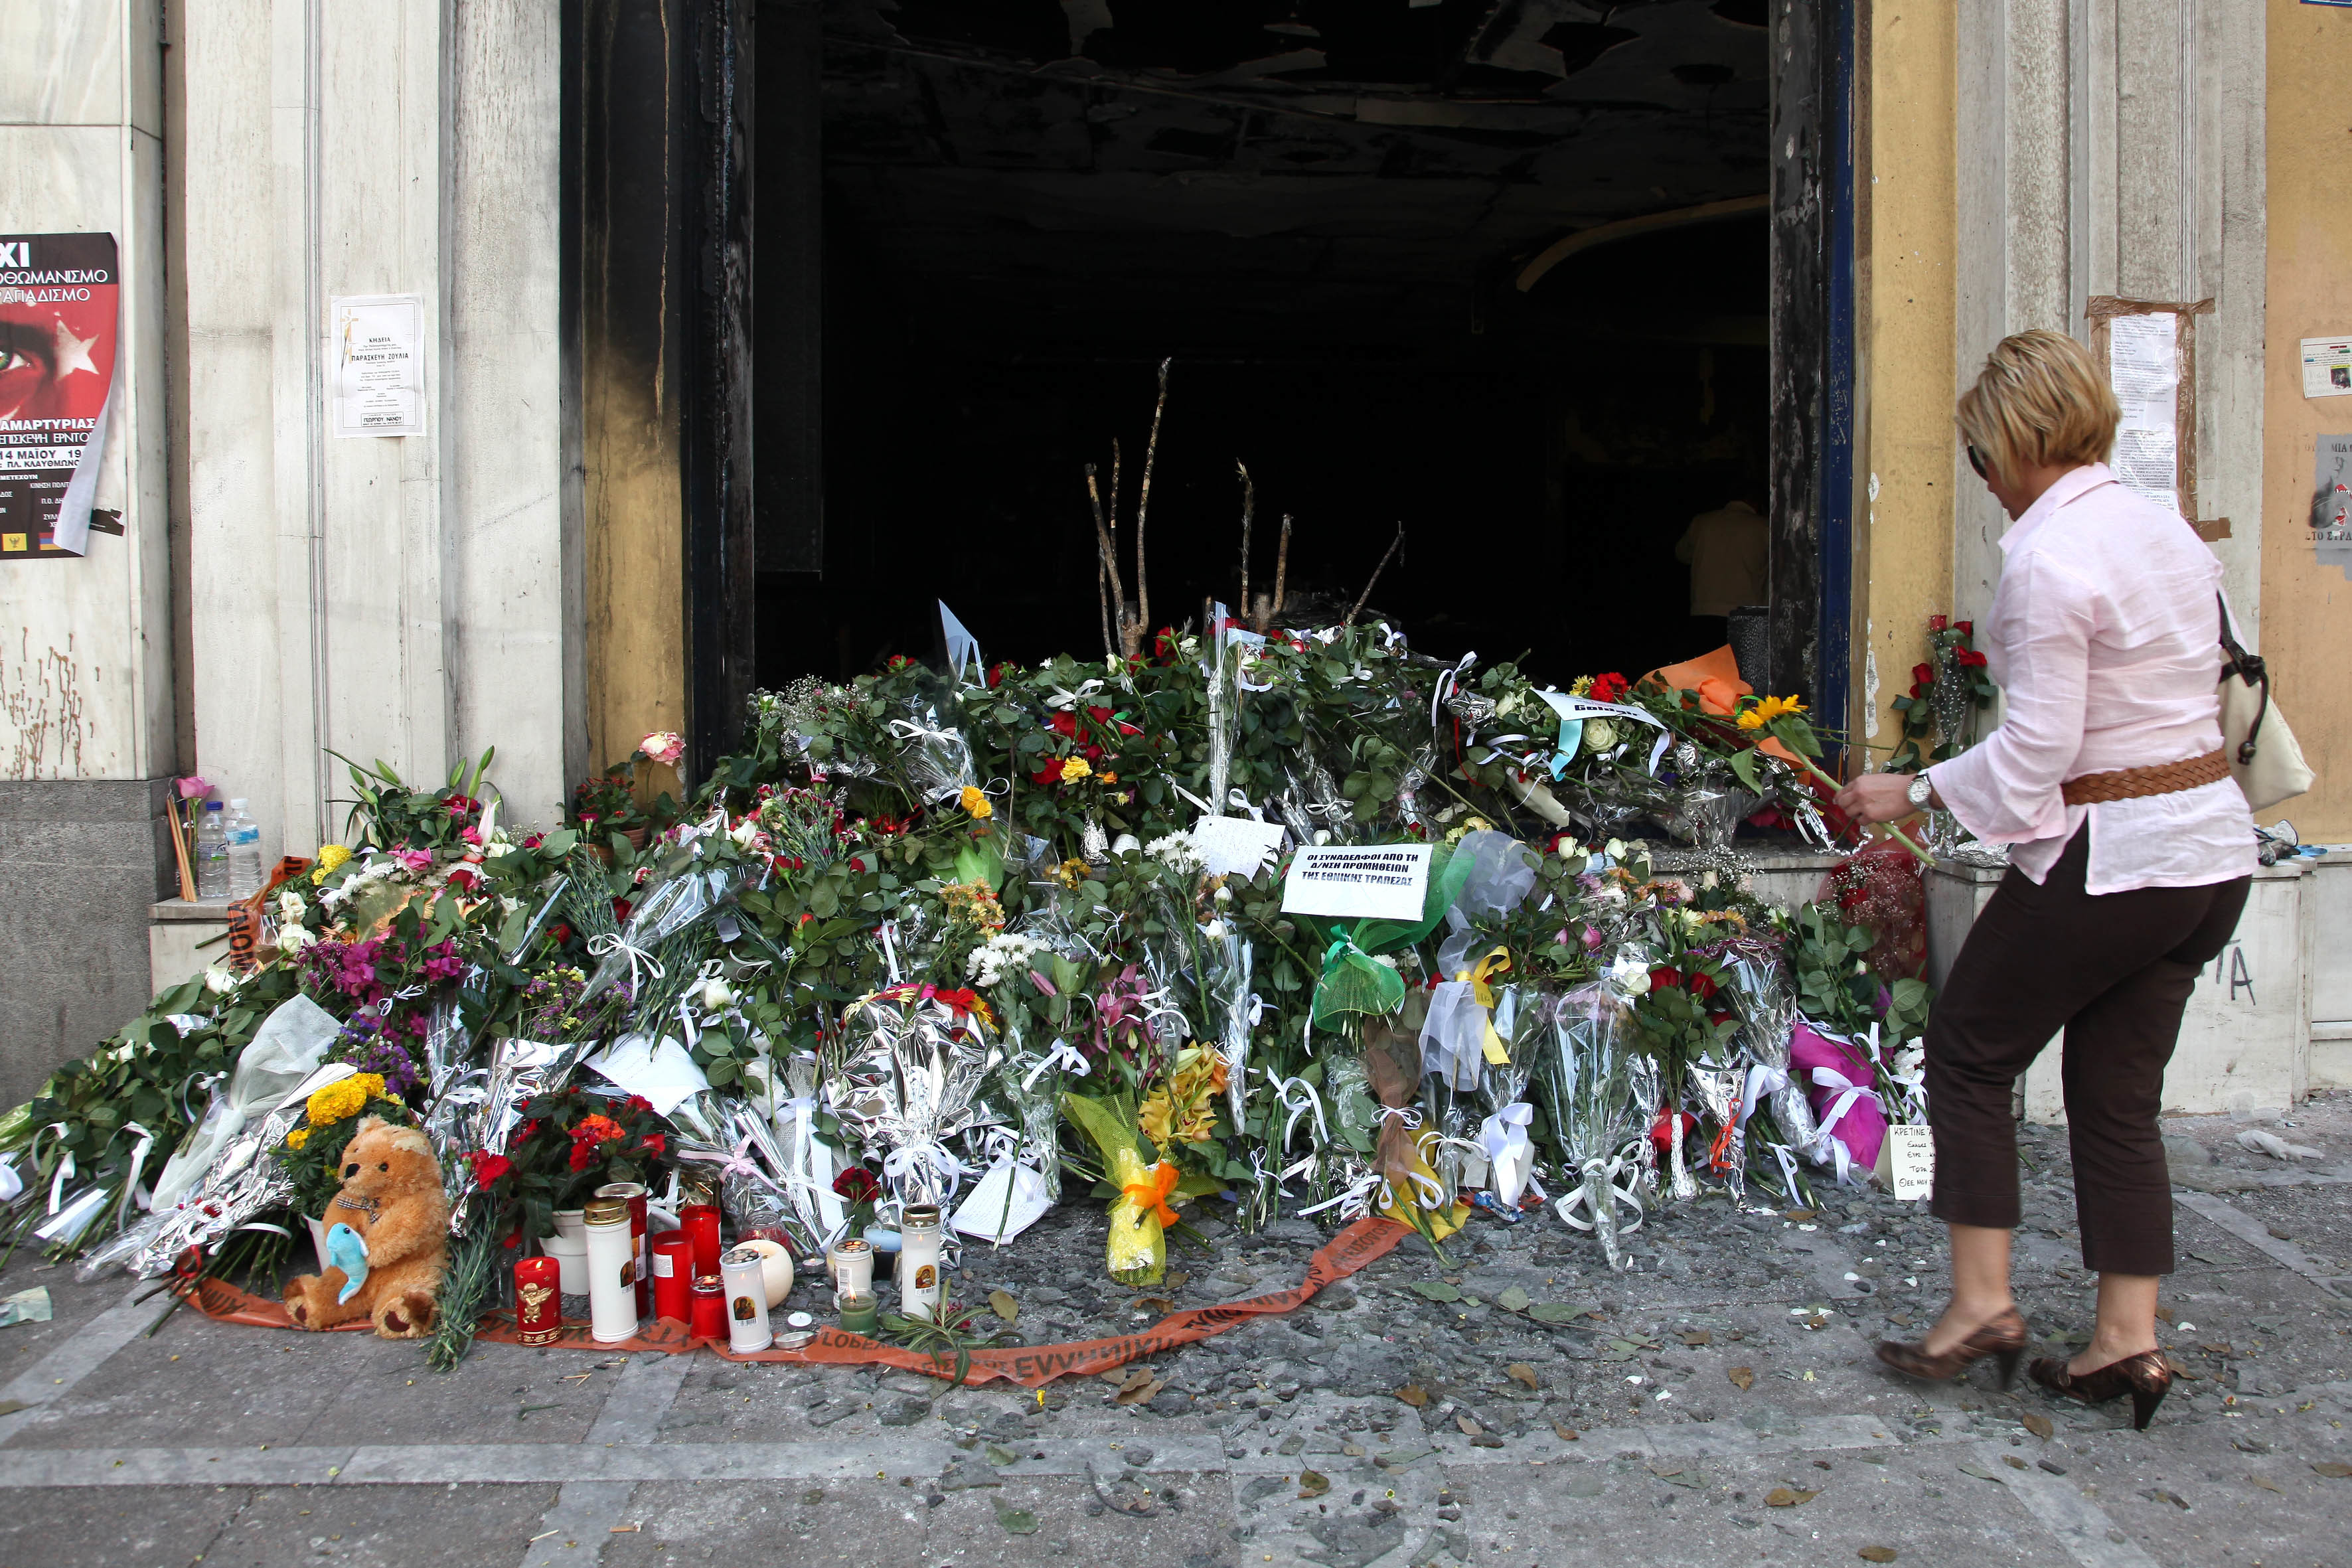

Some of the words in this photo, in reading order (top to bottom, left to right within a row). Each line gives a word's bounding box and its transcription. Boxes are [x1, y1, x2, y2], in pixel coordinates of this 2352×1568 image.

[0, 288, 90, 303] ΑΓΙΑΔΙΣΜΟ
[54, 432, 91, 443] ΕΡΝΤΟ
[1343, 863, 1409, 872] ΠΡΟΜΗΘΕΙΩΝ
[1321, 872, 1363, 882] ΕΘΝΙΚΗΣ
[1366, 875, 1413, 886] ΤΡΑΠΕΖΑΣ
[1894, 1127, 1925, 1136] ΚΡΕΤΙΝΕ
